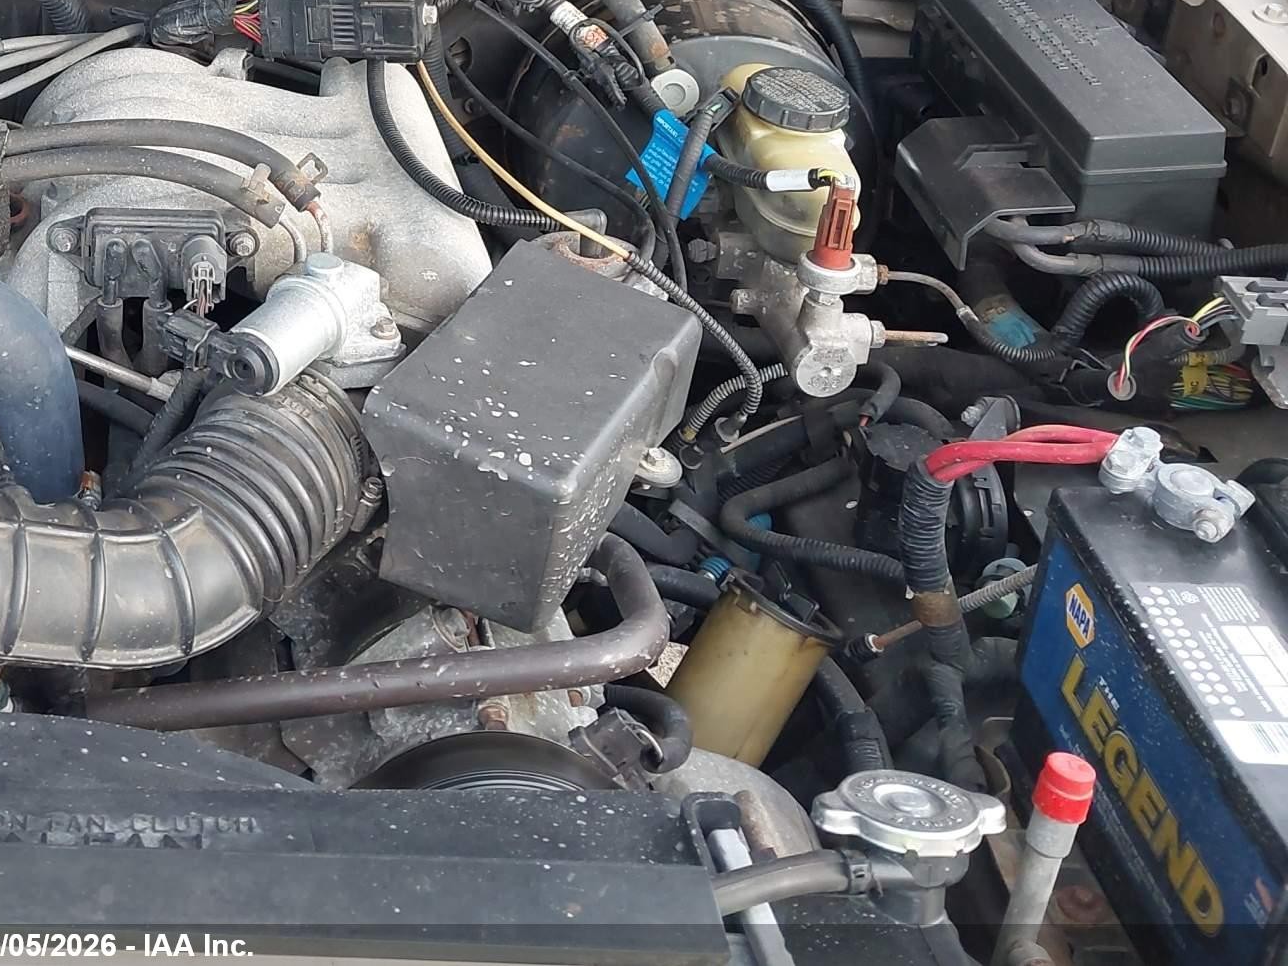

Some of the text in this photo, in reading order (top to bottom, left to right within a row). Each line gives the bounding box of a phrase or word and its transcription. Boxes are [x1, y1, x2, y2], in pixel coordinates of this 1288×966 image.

[1068, 593, 1091, 640] NAPA
[1098, 675, 1121, 711] THE
[1061, 652, 1225, 938] LEGEND
